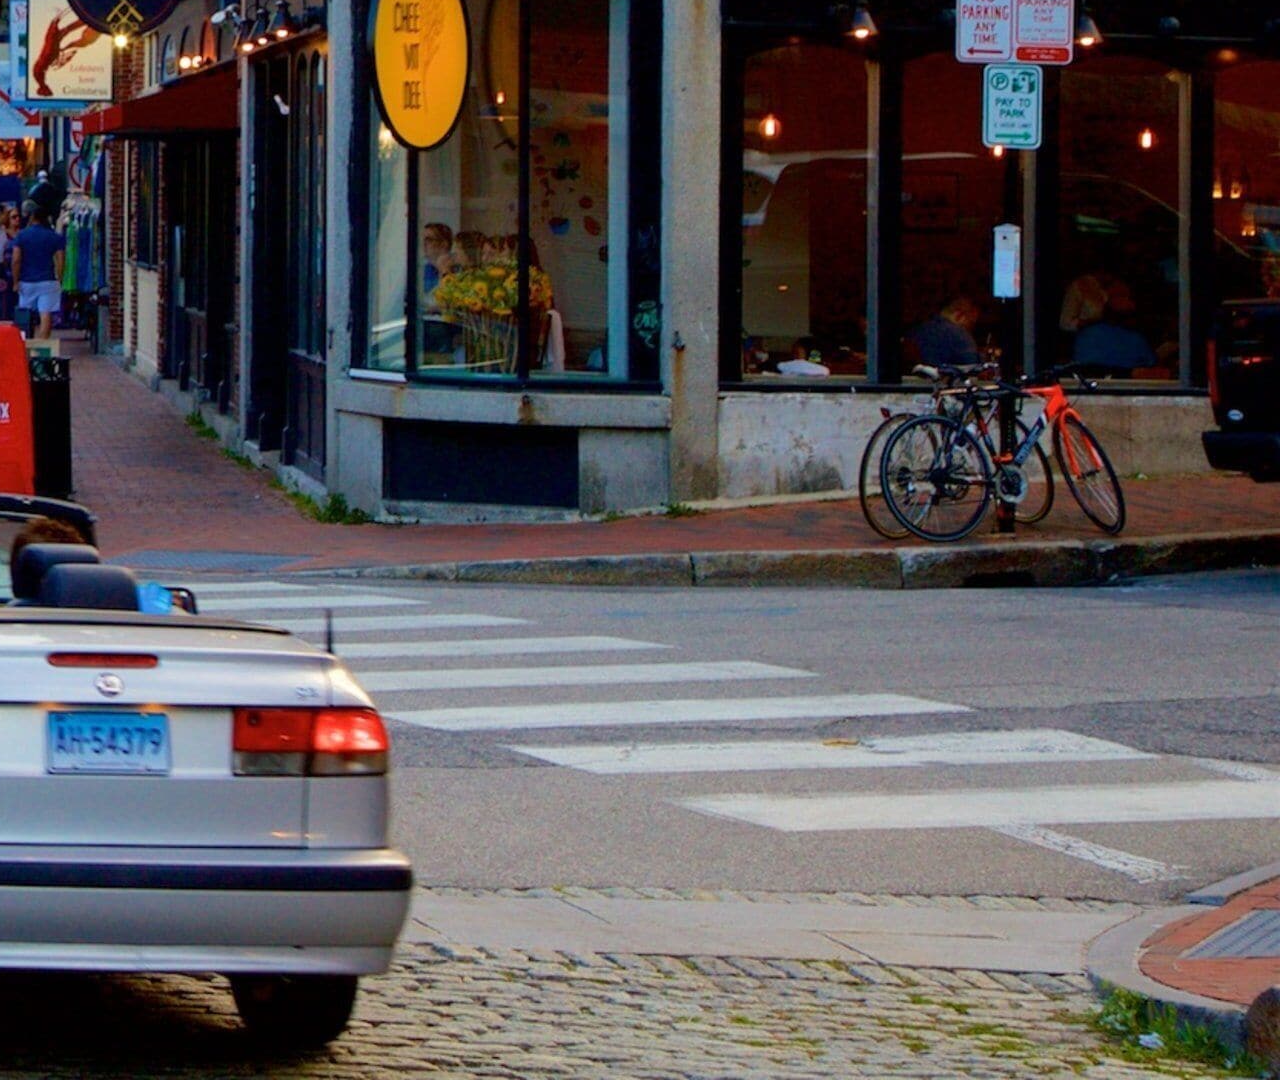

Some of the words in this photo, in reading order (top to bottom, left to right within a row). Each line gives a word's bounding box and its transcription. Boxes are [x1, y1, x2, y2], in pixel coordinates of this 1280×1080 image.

[961, 4, 1010, 21] PARKING
[975, 22, 996, 32] ANY
[973, 33, 998, 44] TIME
[994, 98, 1015, 107] PAY
[1019, 98, 1032, 108] TO
[999, 109, 1025, 119] PARK
